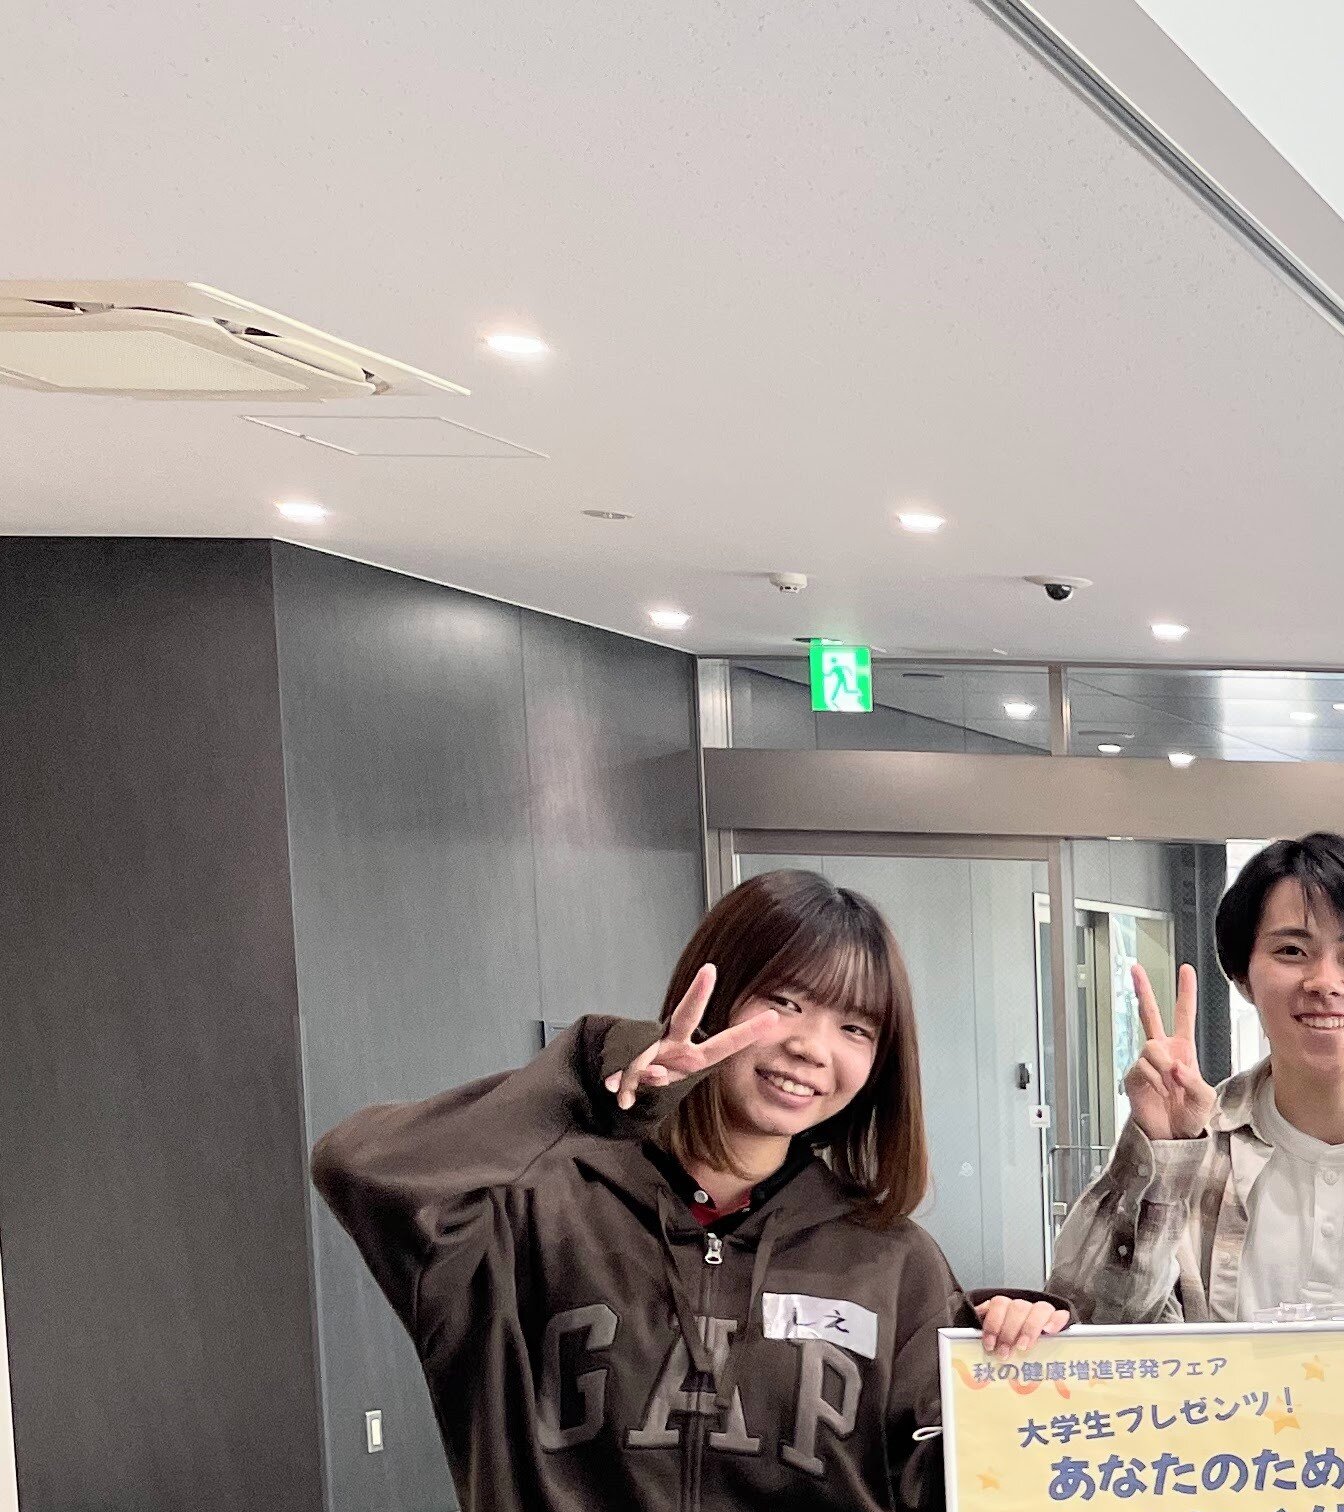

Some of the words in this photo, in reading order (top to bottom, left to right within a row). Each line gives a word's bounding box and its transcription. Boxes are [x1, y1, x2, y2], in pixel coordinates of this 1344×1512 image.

[538, 1303, 864, 1476] GAP
[973, 1357, 1228, 1383] 秋の健康増進啓発フェア
